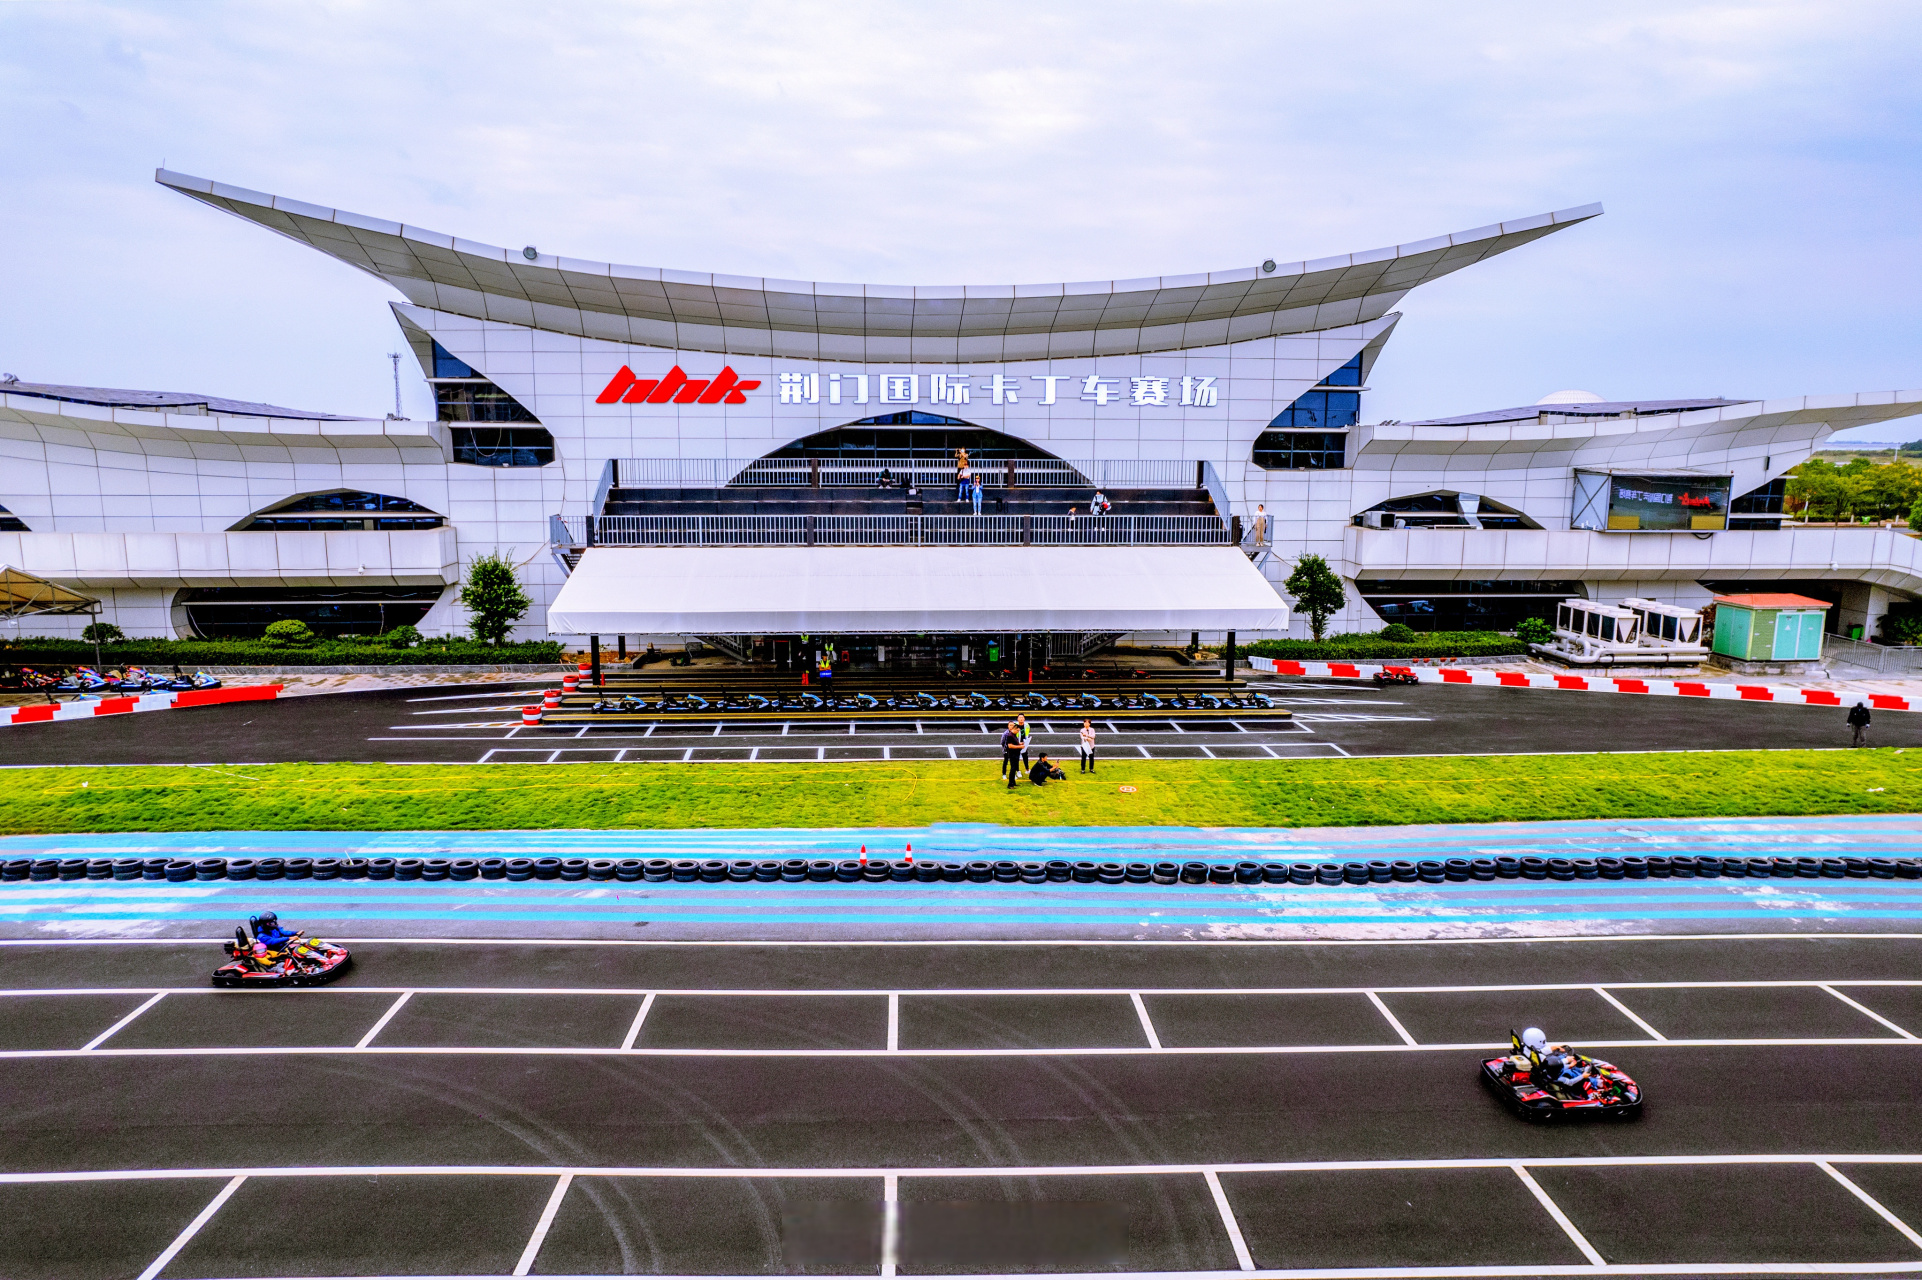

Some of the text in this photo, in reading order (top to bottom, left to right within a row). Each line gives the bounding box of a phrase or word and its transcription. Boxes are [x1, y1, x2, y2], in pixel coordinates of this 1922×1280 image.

[779, 373, 1219, 406] 荆门国际卡丁车赛场
